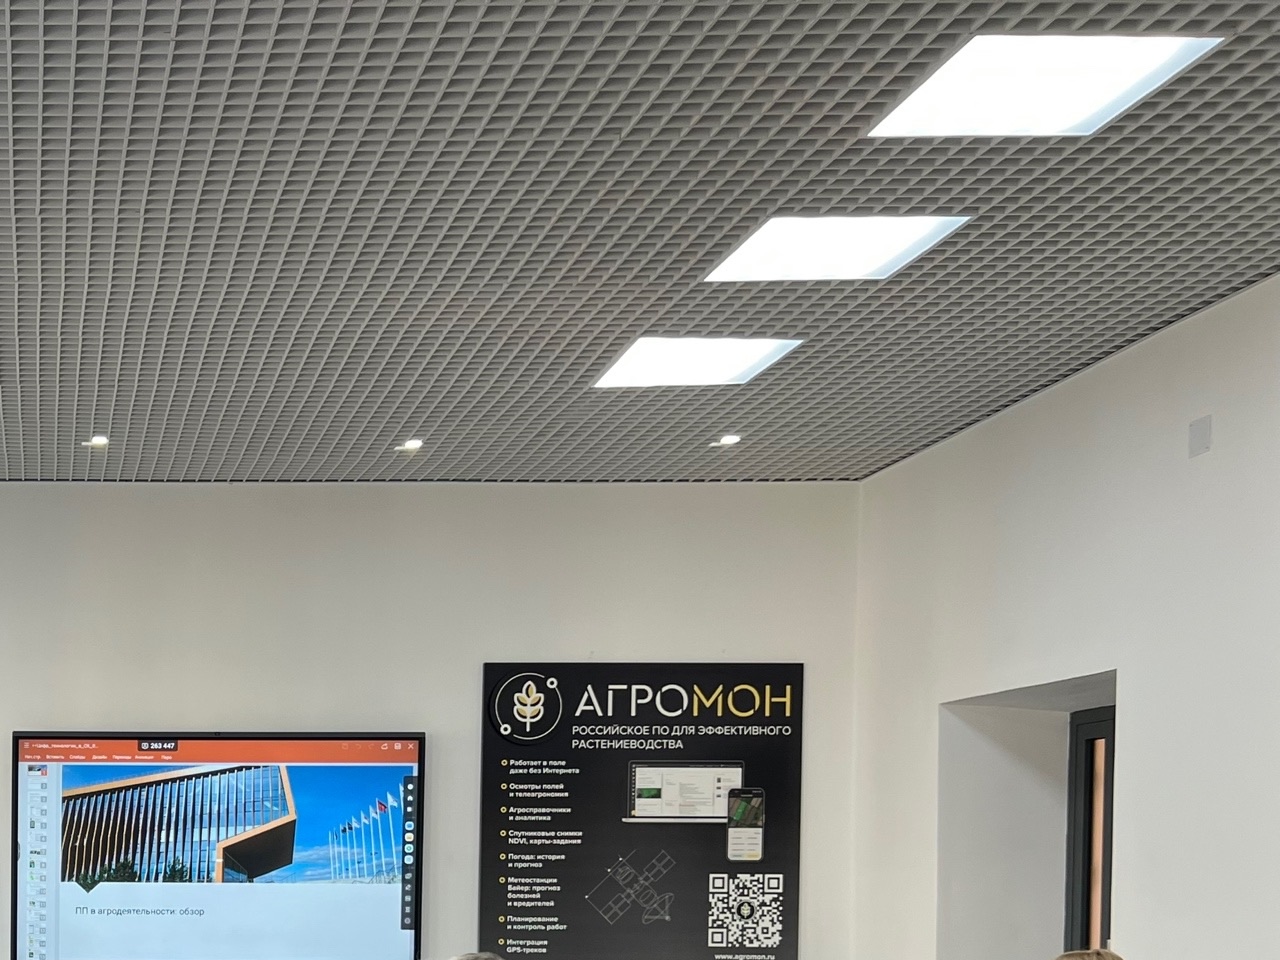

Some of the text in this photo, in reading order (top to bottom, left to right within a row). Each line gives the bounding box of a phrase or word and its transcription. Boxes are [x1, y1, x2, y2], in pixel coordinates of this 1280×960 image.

[574, 684, 791, 718] АГРОМОН
[572, 724, 791, 737] РОССИЙСКОЕ ПО ДЛЯ ЭФФЕКТИВНОГО
[571, 739, 684, 750] РАСТЕНИЕВОДСТВА
[508, 806, 572, 814] Агросправочники
[75, 907, 88, 915] ПП
[179, 907, 205, 917] обзор
[507, 915, 559, 923] Планирование
